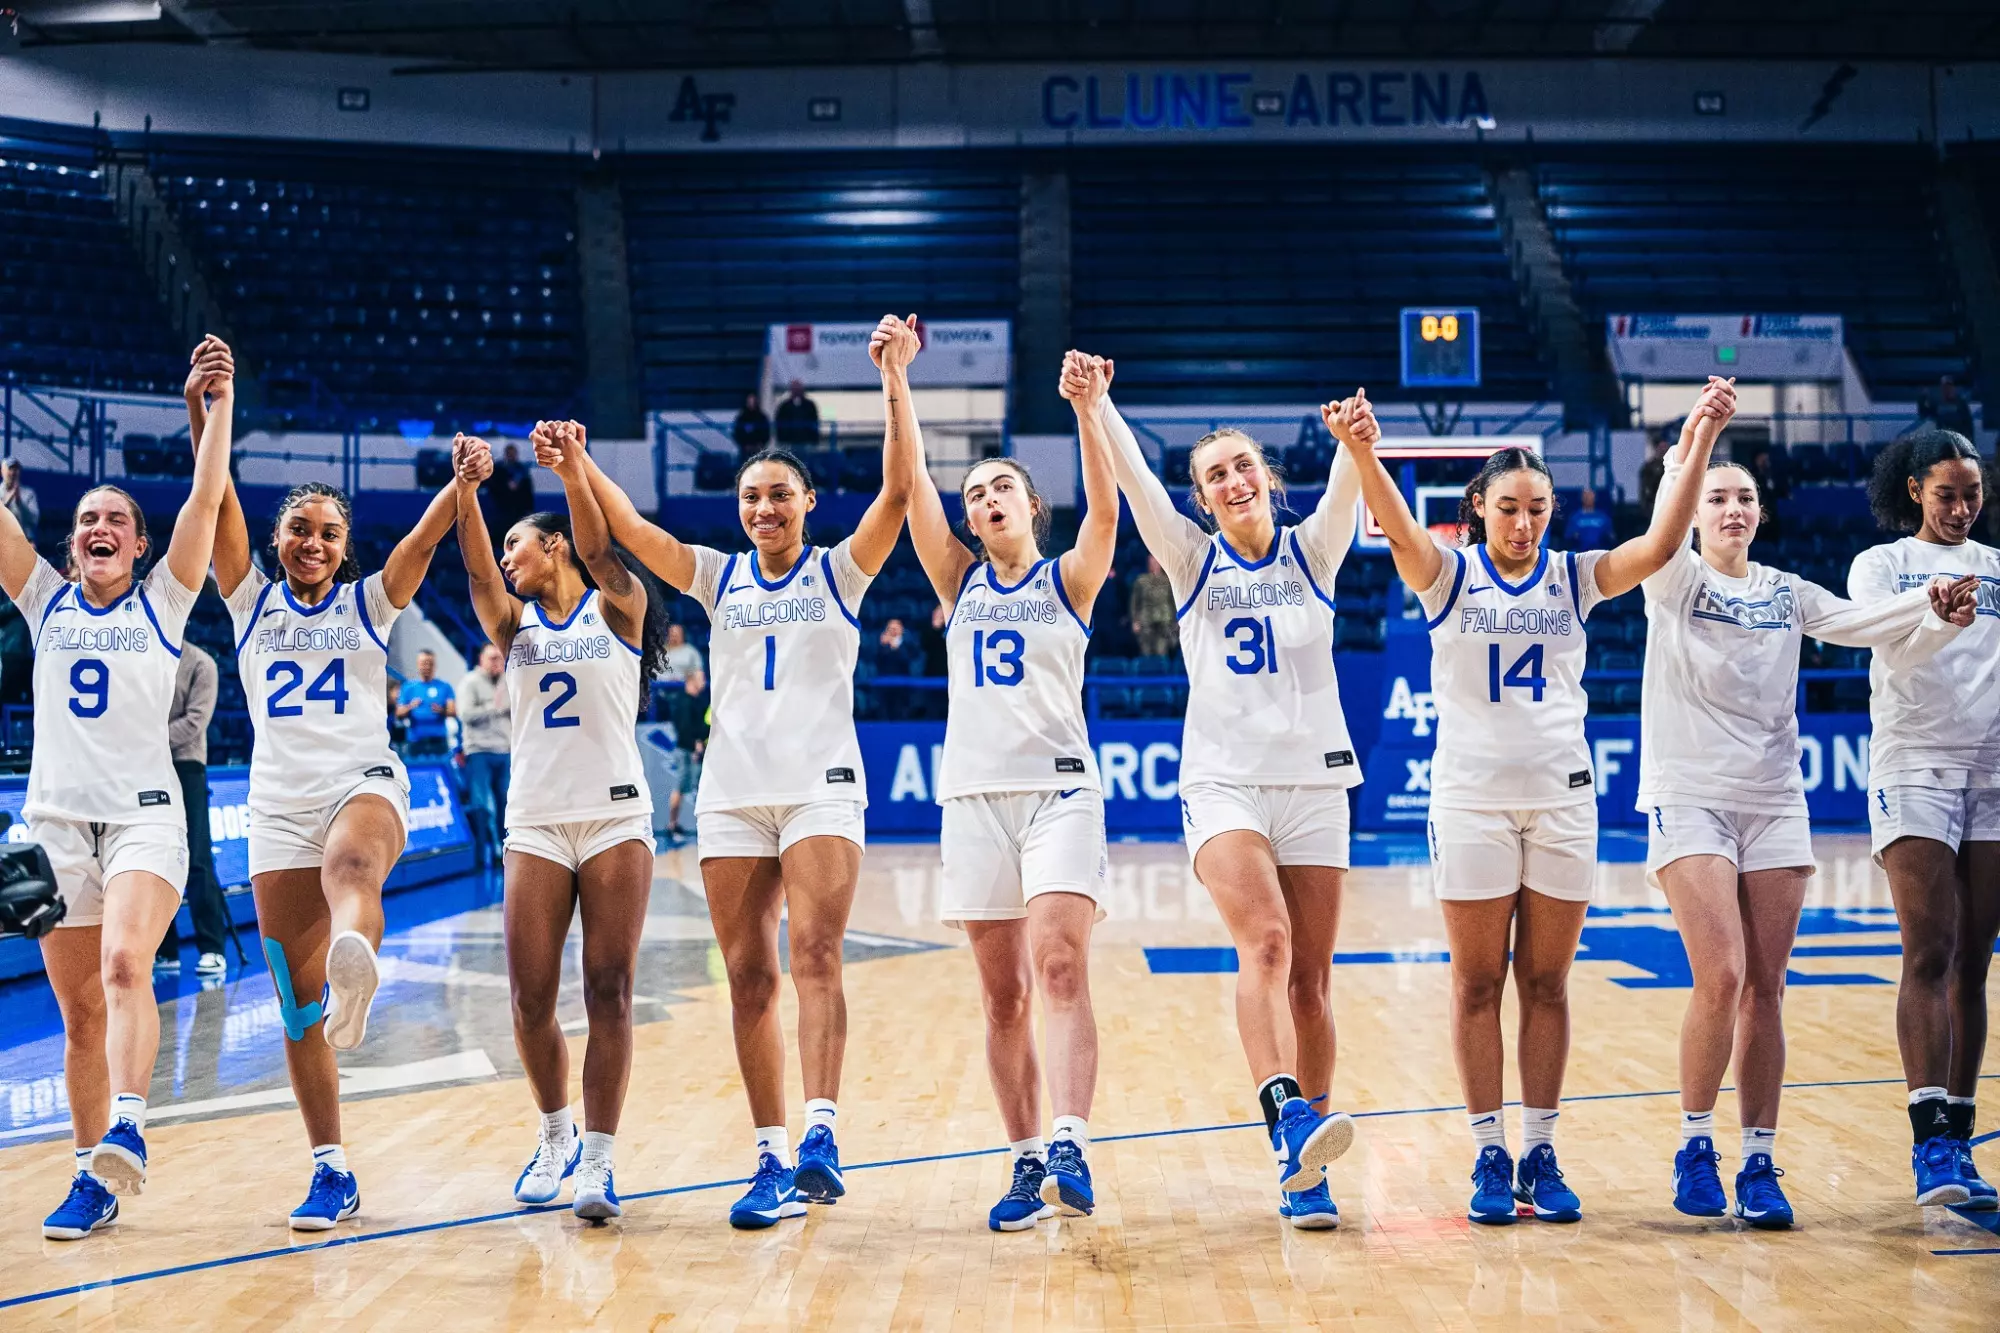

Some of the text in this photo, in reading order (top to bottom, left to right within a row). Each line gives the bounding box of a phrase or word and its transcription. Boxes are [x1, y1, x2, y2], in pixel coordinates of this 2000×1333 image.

[1042, 71, 1488, 129] CLUNE ARENA
[724, 598, 826, 630] FALCONS
[954, 600, 1057, 625] FALCONS
[1208, 581, 1304, 610] FALCONS
[1461, 608, 1572, 636] FALCONS
[45, 627, 149, 652] FALCONS
[255, 627, 361, 654] FALCONS
[511, 636, 611, 669] FALCONS
[764, 635, 776, 690] 1
[973, 629, 1025, 687] 13
[1224, 615, 1278, 675] 31
[68, 658, 109, 718] 9
[266, 657, 349, 718] 24
[539, 671, 580, 729] 2
[1488, 643, 1546, 702] 14
